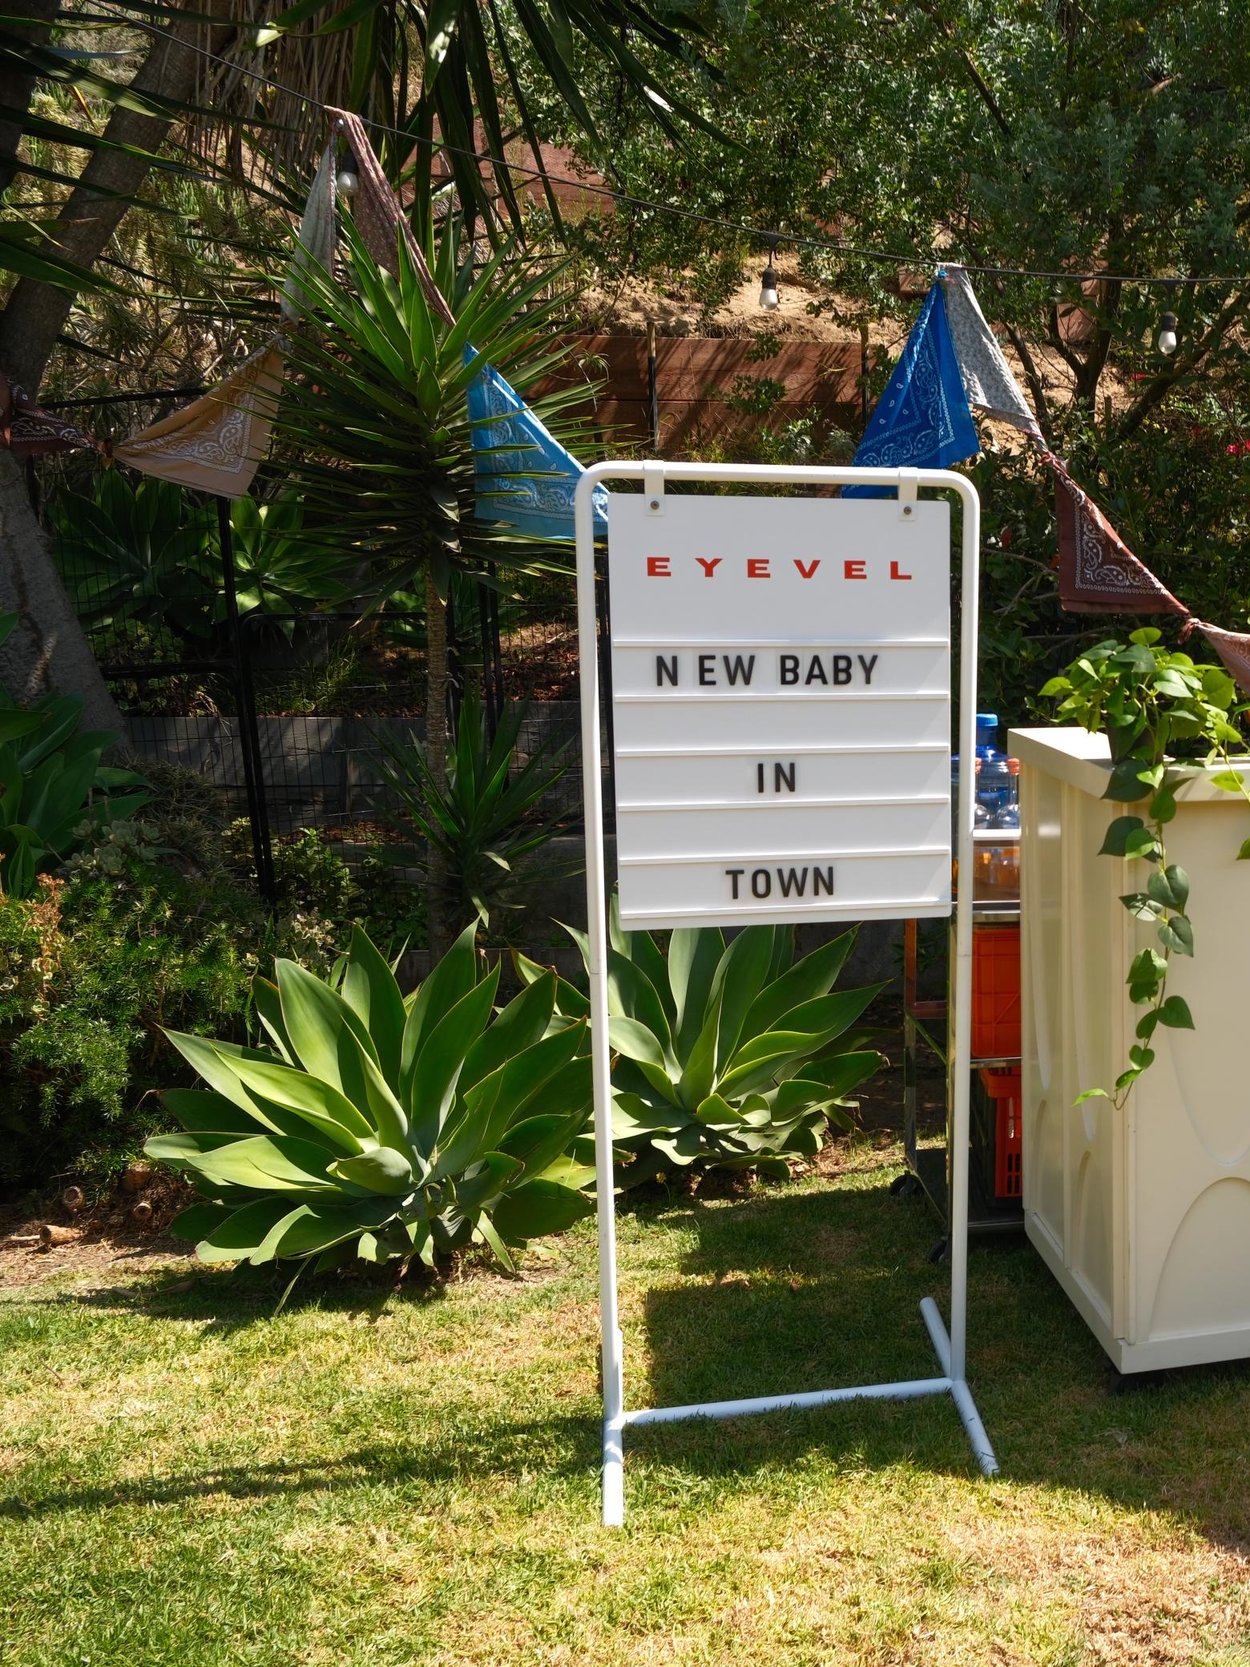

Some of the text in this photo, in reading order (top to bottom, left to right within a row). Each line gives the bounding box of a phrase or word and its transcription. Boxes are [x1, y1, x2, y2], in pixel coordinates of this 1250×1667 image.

[647, 557, 912, 580] EYEVEL
[656, 654, 879, 687] NEW BABY
[757, 763, 796, 793] IN
[725, 867, 834, 899] TOWN
